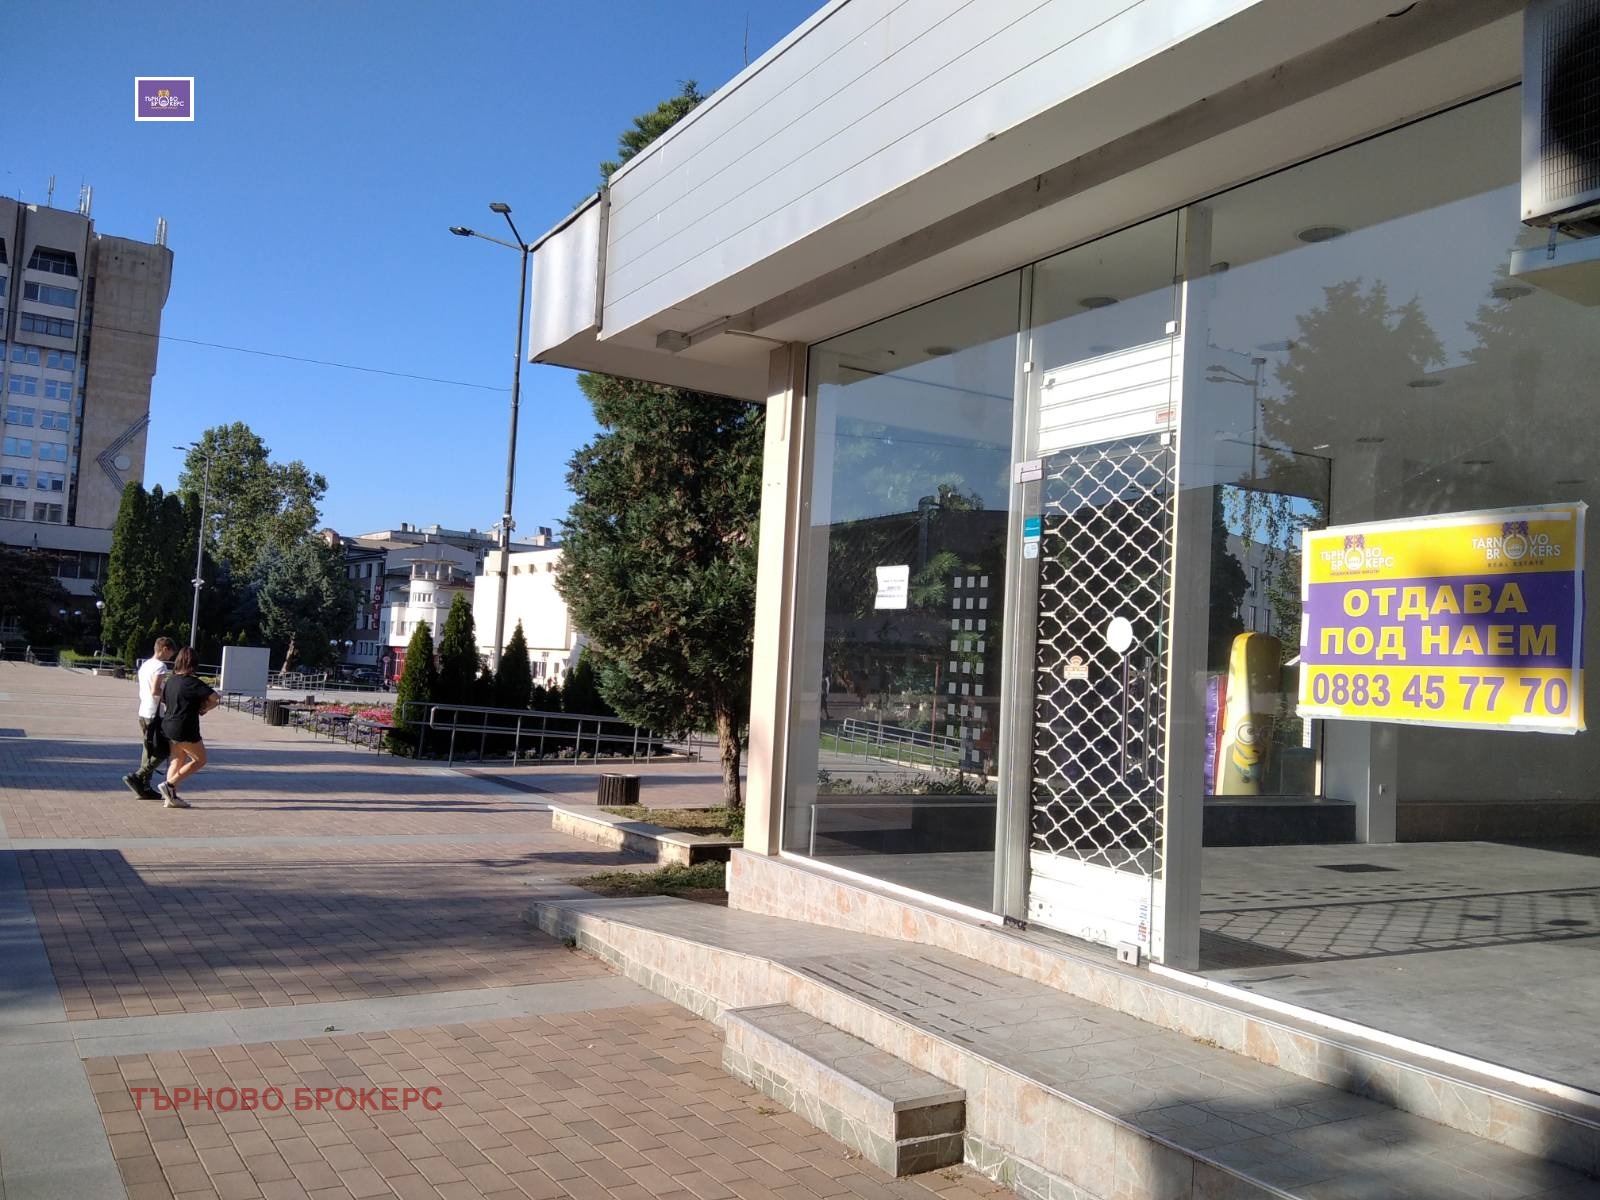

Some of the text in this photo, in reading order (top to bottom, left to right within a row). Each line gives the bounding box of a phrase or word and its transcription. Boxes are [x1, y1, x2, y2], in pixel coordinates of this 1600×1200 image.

[373, 585, 381, 629] HOTEL
[1343, 582, 1528, 621] ОТДАВА
[1320, 624, 1556, 660] ПОД НАЕМ
[1313, 673, 1568, 715] 0883 45 77 70
